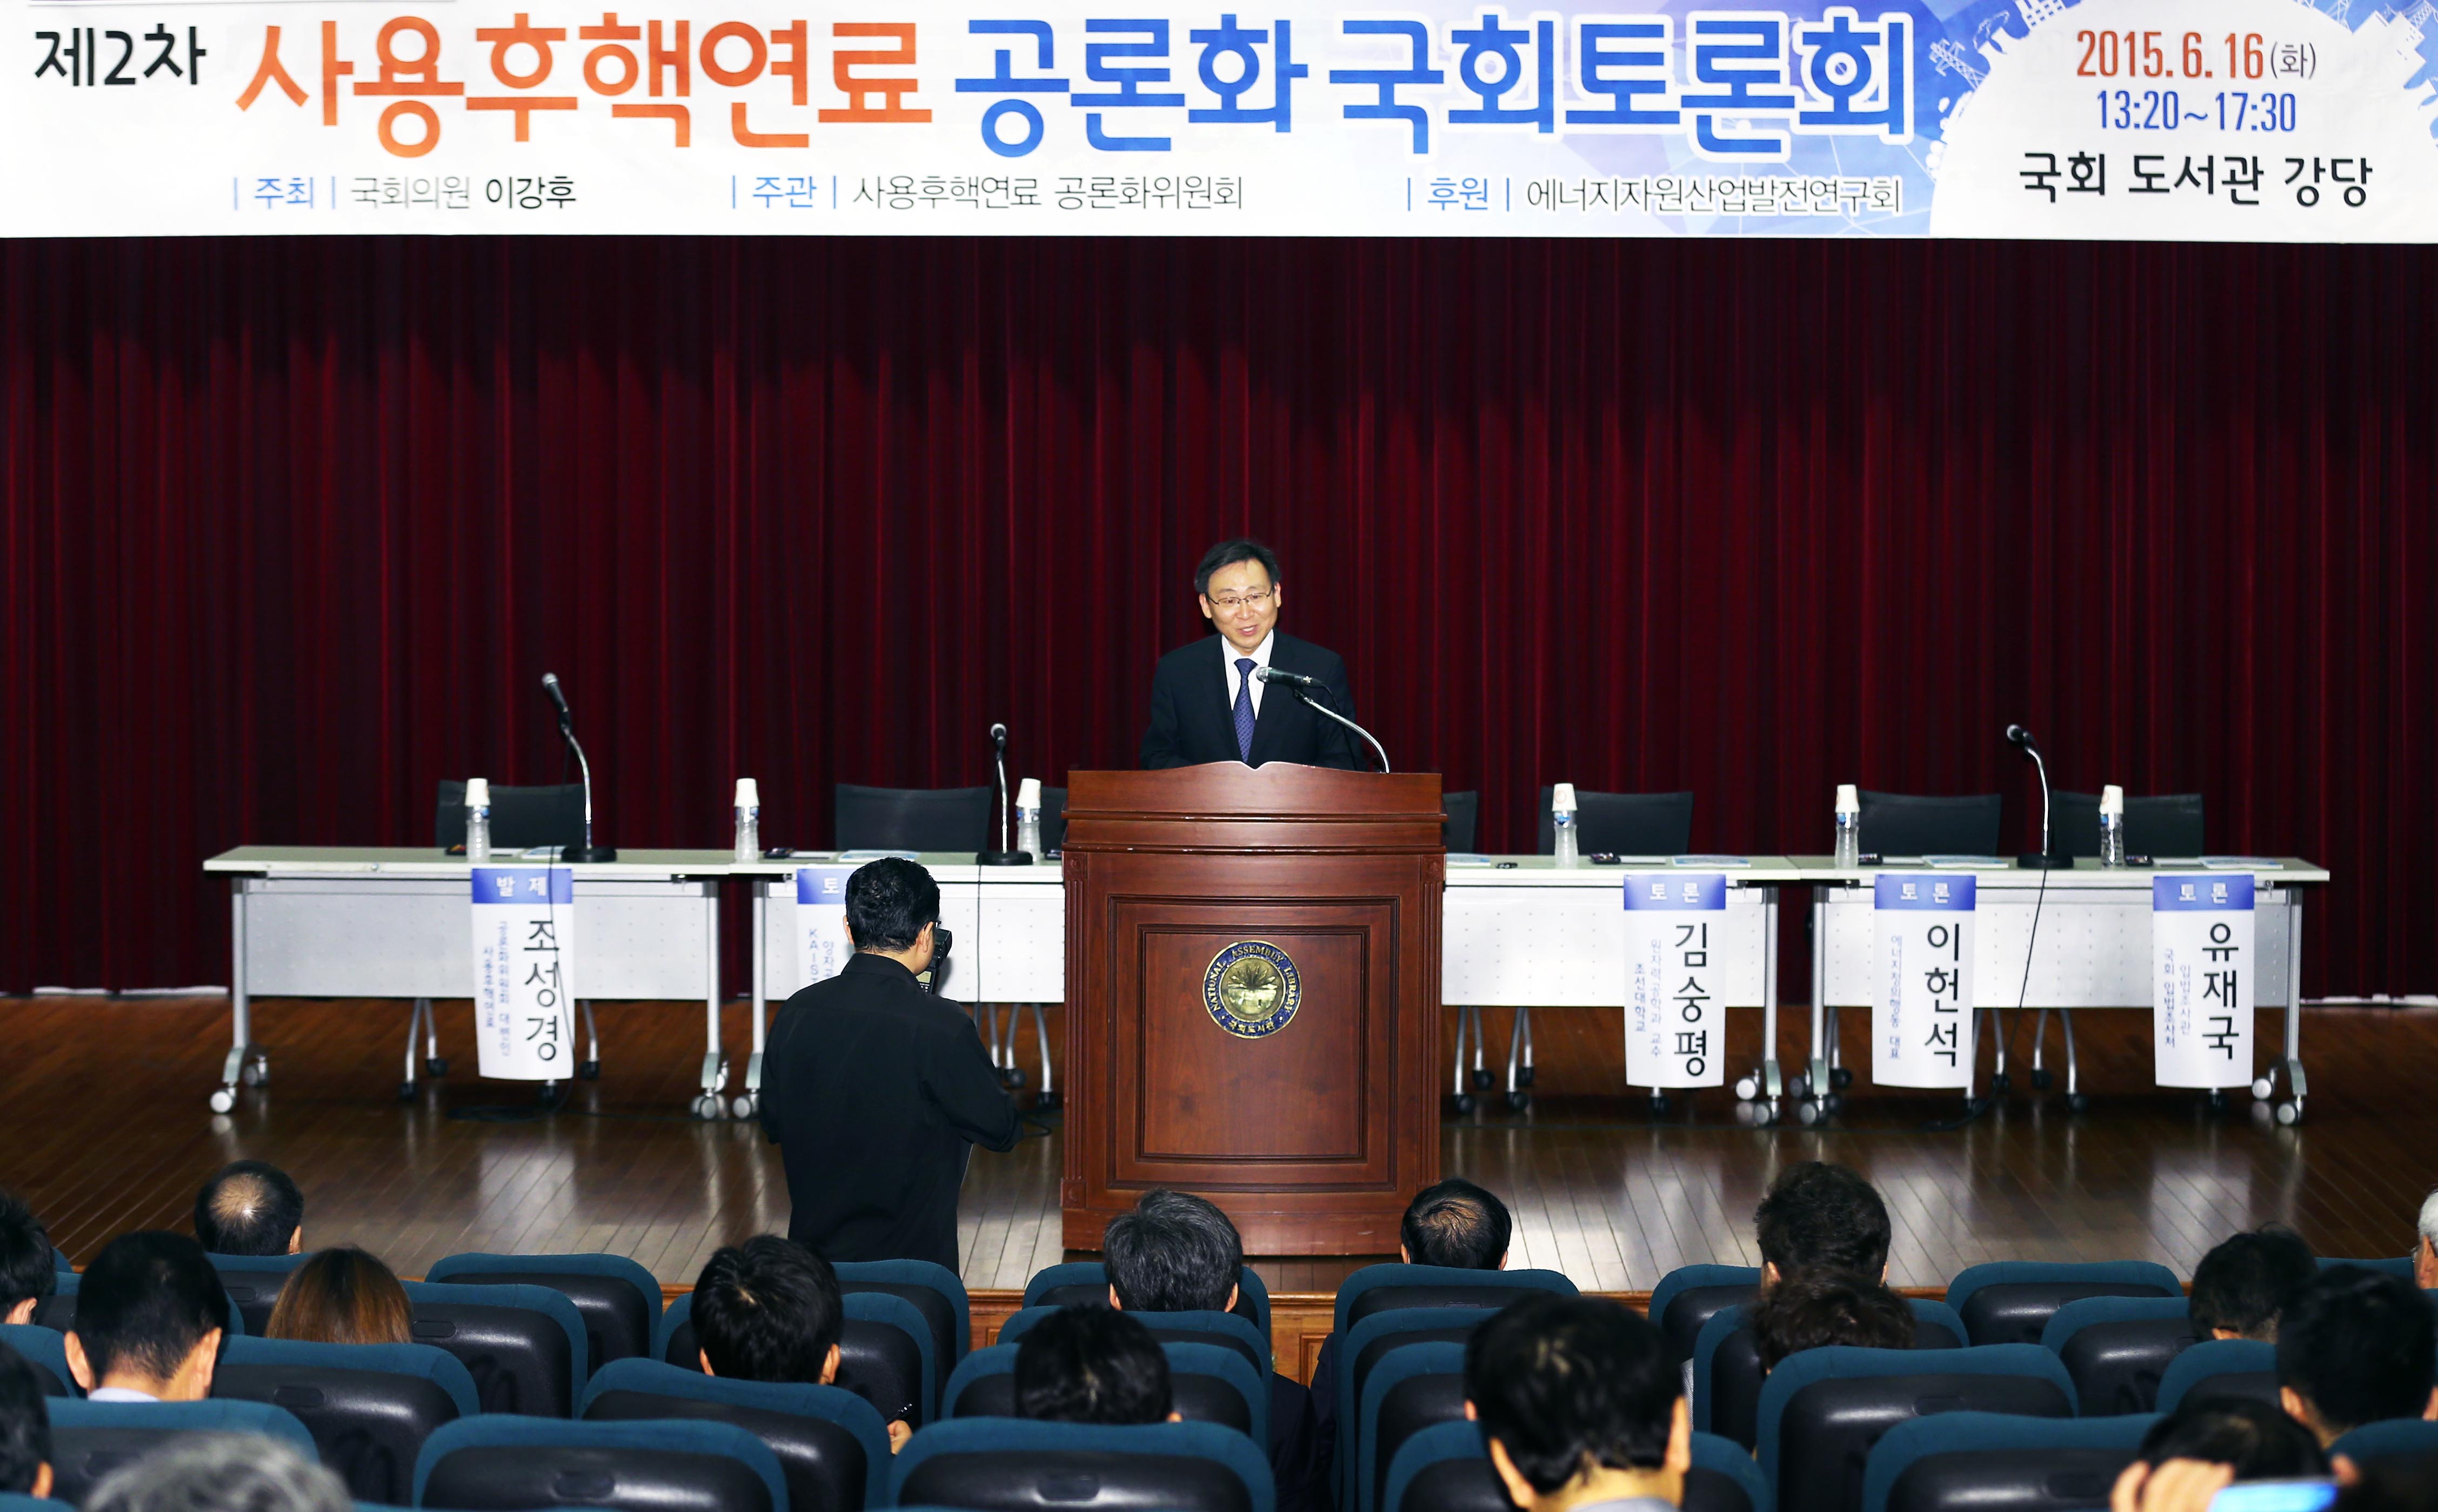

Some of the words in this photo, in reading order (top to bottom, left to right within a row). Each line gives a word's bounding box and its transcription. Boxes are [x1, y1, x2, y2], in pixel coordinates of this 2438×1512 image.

[34, 23, 208, 88] 제2차
[235, 12, 933, 158] 사용후핵연료
[954, 14, 1310, 158] 공론화
[1328, 13, 1905, 155] 국회토론회
[253, 176, 315, 210] 주최
[350, 176, 470, 210] 국회의원
[485, 176, 577, 210] 이강후
[752, 176, 818, 209] 주관
[852, 175, 1043, 210] 사용후핵연료
[1054, 176, 1243, 210] 공론화위원회
[1427, 177, 1488, 211] 후원
[1527, 176, 1902, 213] 에너지자원산업발전연구회
[2019, 151, 2106, 203] 국회
[2128, 155, 2265, 206] 도서관
[2284, 157, 2374, 208] 강당
[523, 919, 560, 1061] 조성경
[1207, 961, 1225, 1012] NATIONAL
[1232, 946, 1284, 963] ASSEMBLY
[1283, 966, 1297, 1013] LIBRARY
[1672, 922, 1711, 1078] 김승평
[1924, 922, 1960, 1068] 이헌석
[2201, 922, 2240, 1061] 유재국
